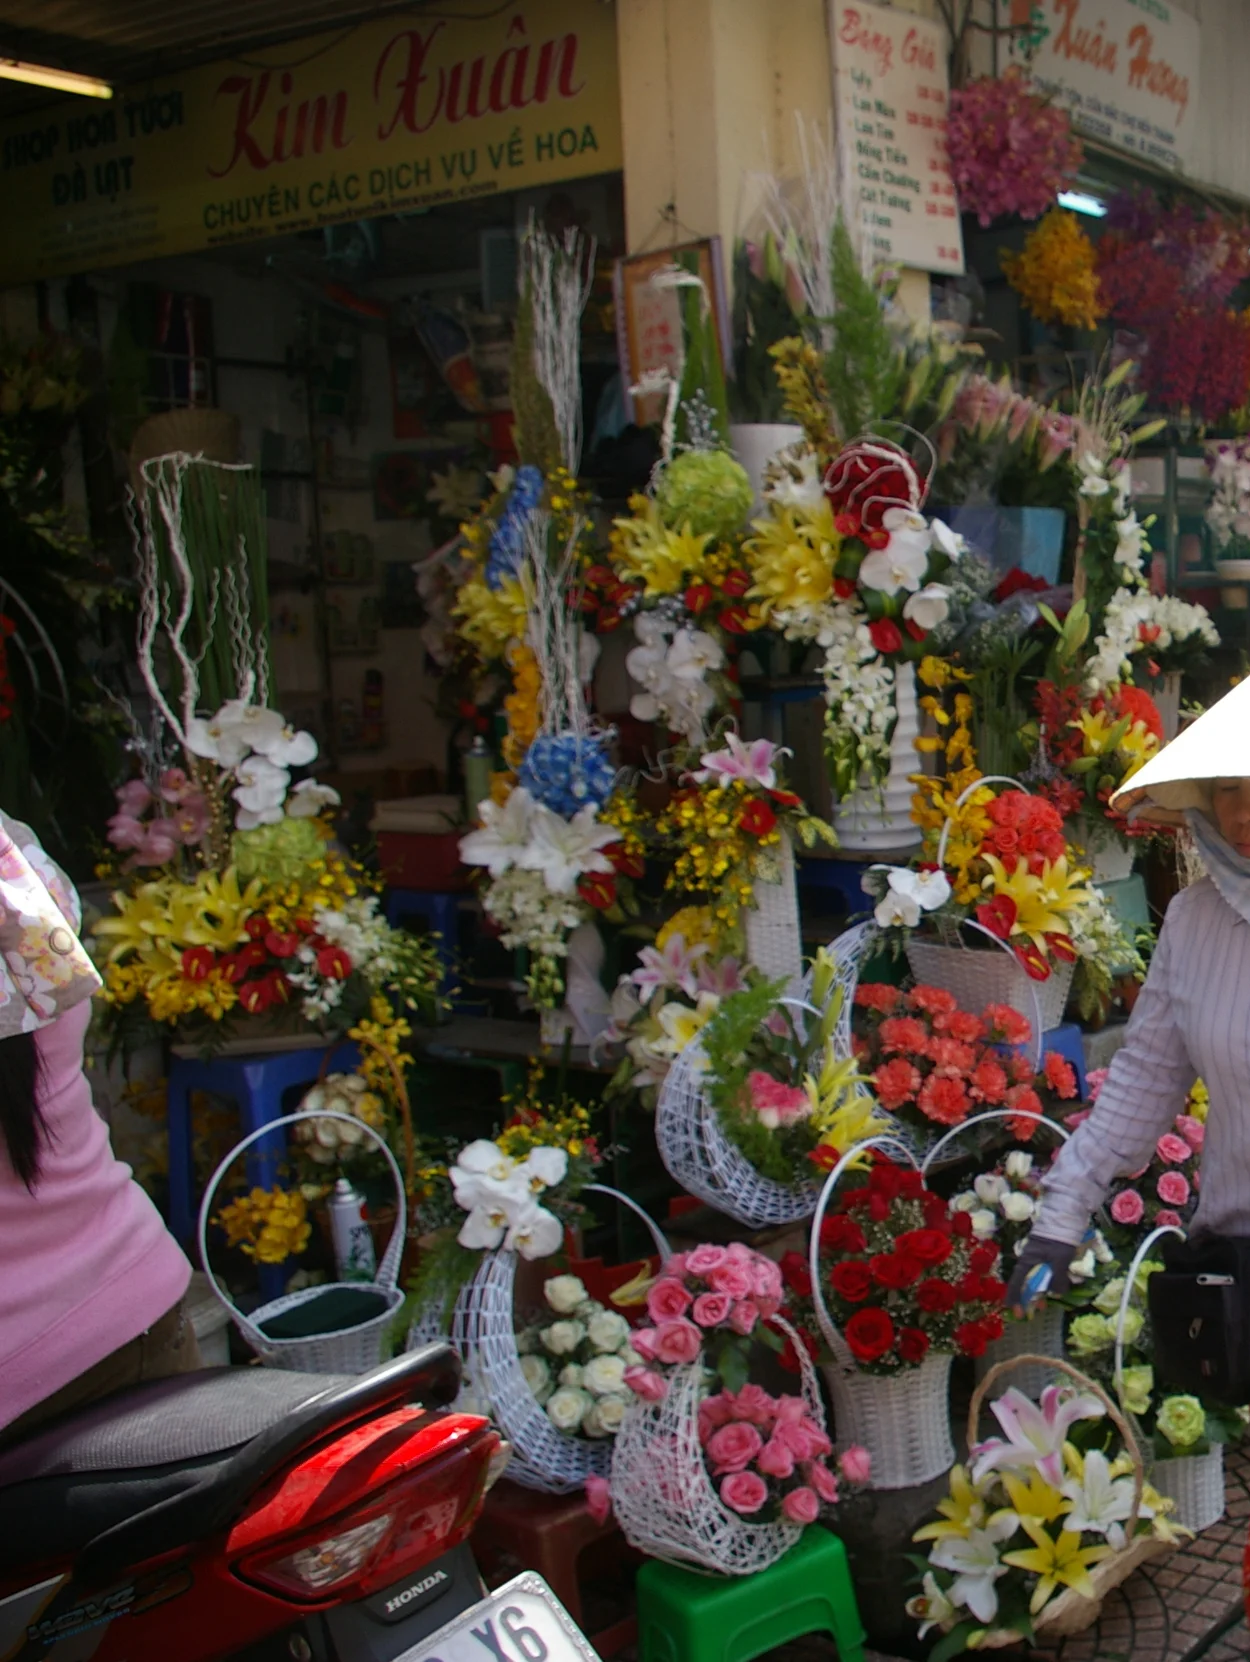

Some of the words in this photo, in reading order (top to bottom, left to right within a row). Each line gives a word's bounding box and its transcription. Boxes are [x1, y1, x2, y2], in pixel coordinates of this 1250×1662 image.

[206, 69, 355, 178] Kim
[374, 15, 586, 141] Xuân
[3, 124, 59, 170] SHOP
[66, 109, 116, 153] HOA
[52, 161, 87, 206] ĐÀ
[95, 156, 134, 202] LẠT
[203, 185, 300, 230] CHUYÊN
[308, 173, 361, 208] CÁC
[369, 158, 432, 198] DỊCH
[440, 149, 477, 182] VỤ
[487, 127, 524, 169] VỀ
[536, 124, 599, 162] HOA
[385, 1569, 448, 1614] HONDA
